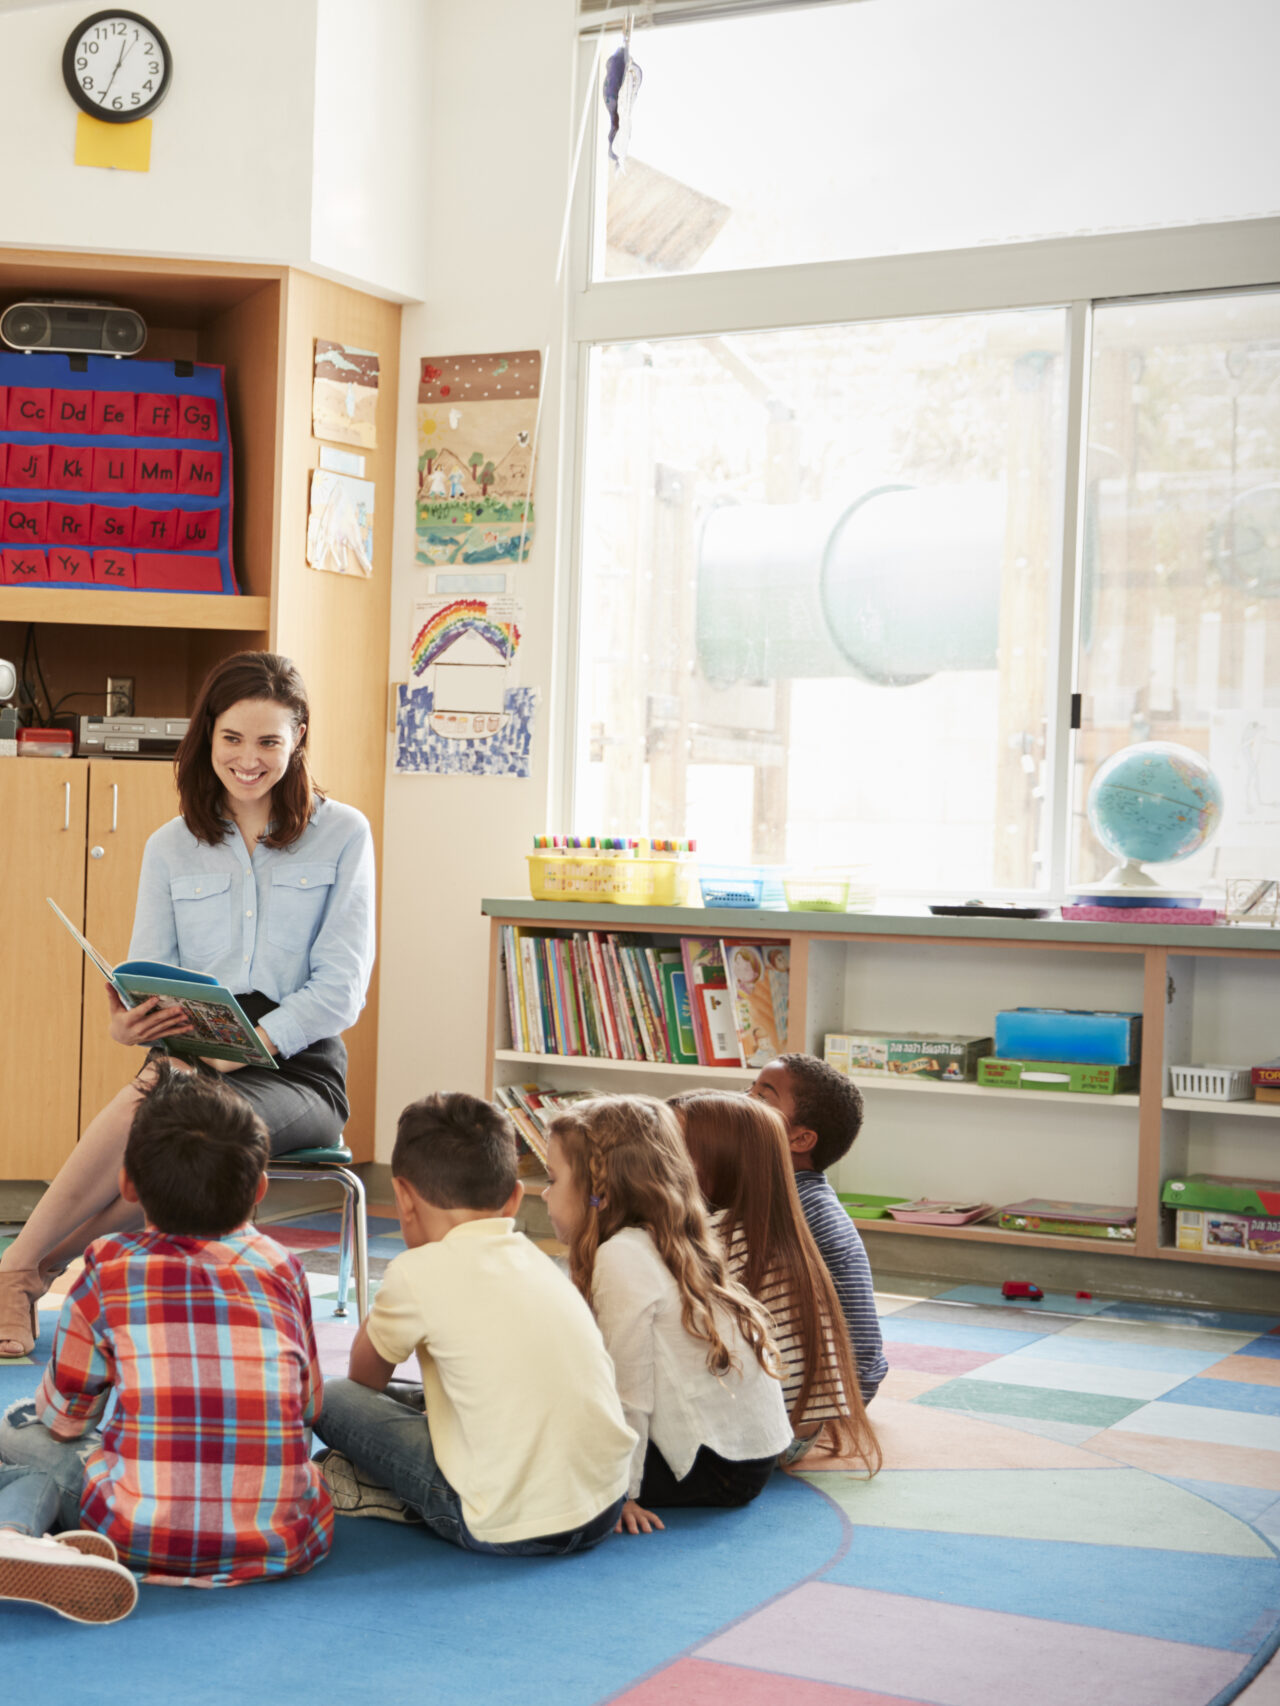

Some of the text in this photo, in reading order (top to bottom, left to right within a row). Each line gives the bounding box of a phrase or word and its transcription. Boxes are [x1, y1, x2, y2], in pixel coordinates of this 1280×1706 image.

[94, 27, 108, 40] 11
[110, 23, 127, 36] 12
[133, 29, 139, 41] 1
[82, 41, 99, 55] 10
[144, 42, 154, 55] 2
[76, 57, 88, 71] 9
[148, 61, 159, 75] 3
[82, 76, 94, 90] 8
[142, 80, 153, 92] 4
[97, 91, 107, 104] 7
[112, 97, 123, 110] 6
[131, 92, 141, 105] 5
[19, 401, 46, 420] Cc
[60, 402, 87, 422] Dd
[103, 405, 125, 423] Ee
[152, 408, 171, 425] Ff
[183, 406, 211, 433] Gg
[21, 456, 38, 479] Jj
[62, 460, 83, 478] Kk
[108, 461, 125, 480] Ll
[141, 463, 173, 481] Mm
[189, 464, 214, 483] Nn
[7, 512, 39, 536] Qq
[61, 516, 83, 534] Rr
[103, 518, 125, 536] Ss
[150, 521, 167, 539] Tt
[185, 524, 207, 541] Uu
[11, 560, 37, 575] Xx
[57, 556, 80, 576] Yy
[103, 560, 126, 577] Zz
